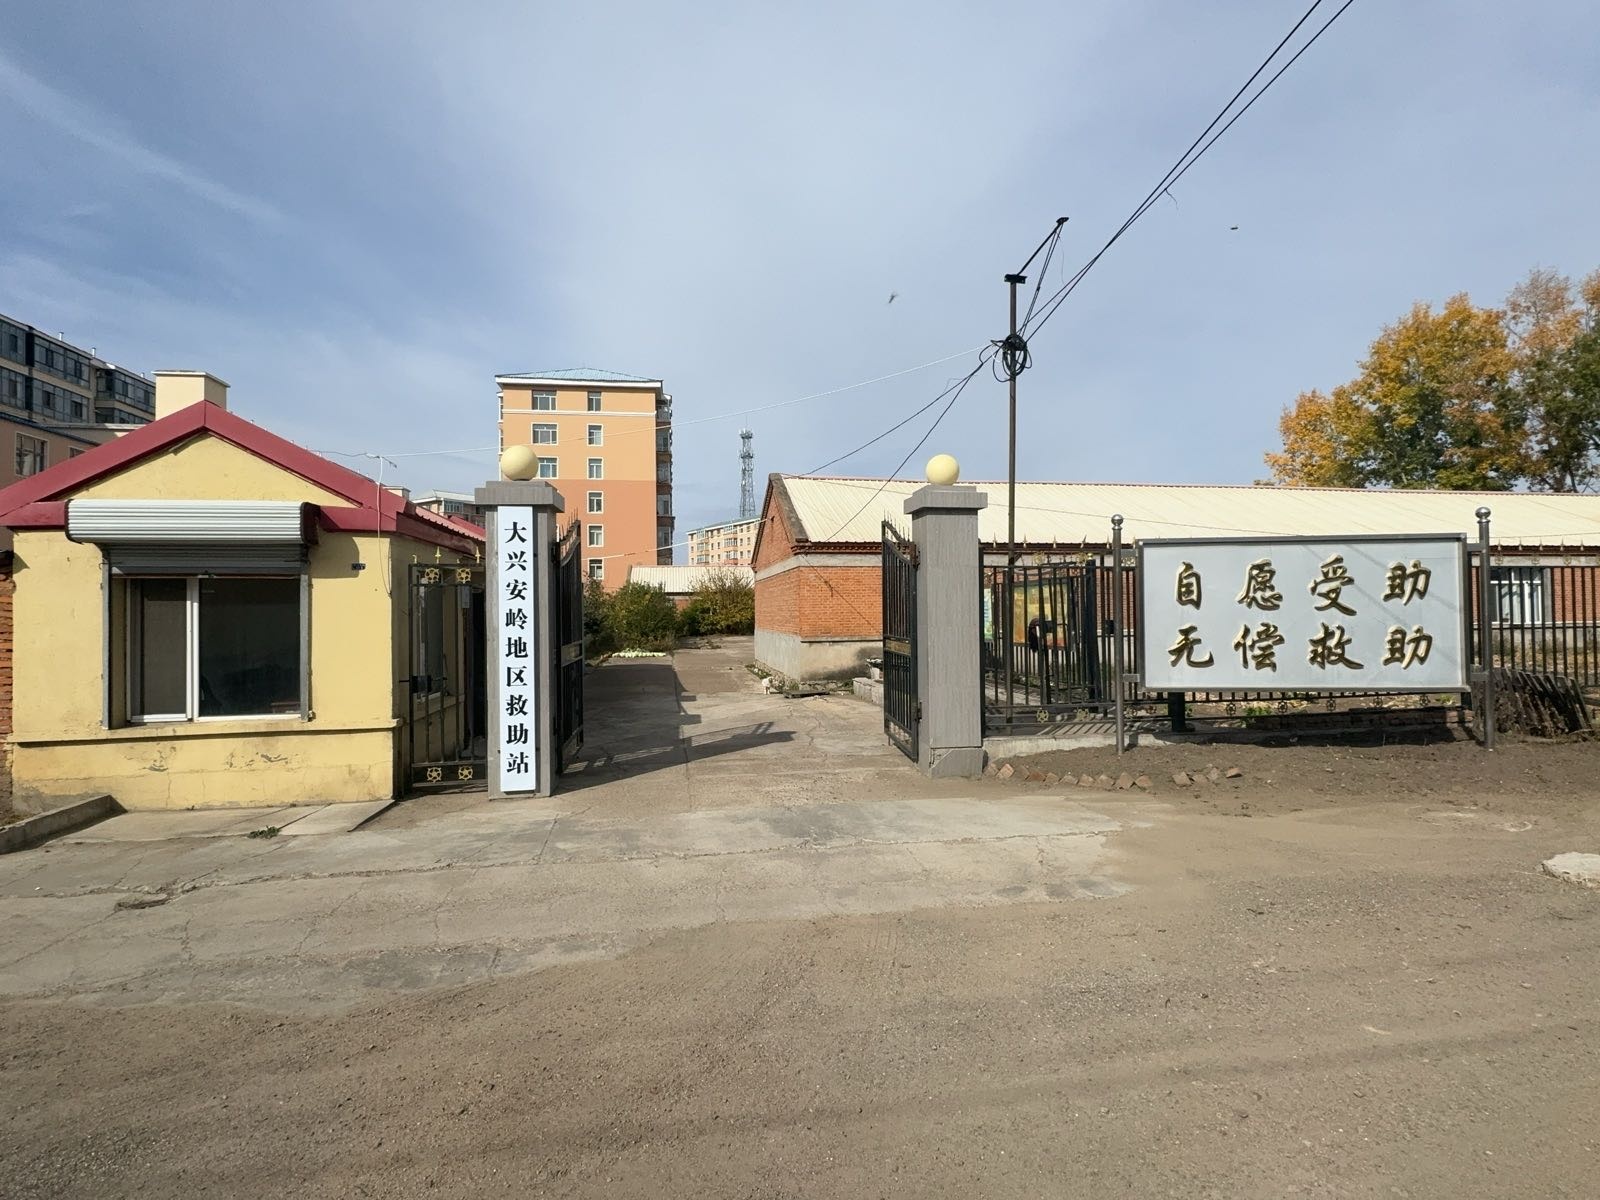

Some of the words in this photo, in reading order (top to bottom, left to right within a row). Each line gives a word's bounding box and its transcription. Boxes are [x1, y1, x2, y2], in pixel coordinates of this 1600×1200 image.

[1175, 554, 1432, 616] 自愿受助
[504, 521, 529, 774] 大兴安岭地区救助站
[1168, 622, 1433, 672] 无偿救助
